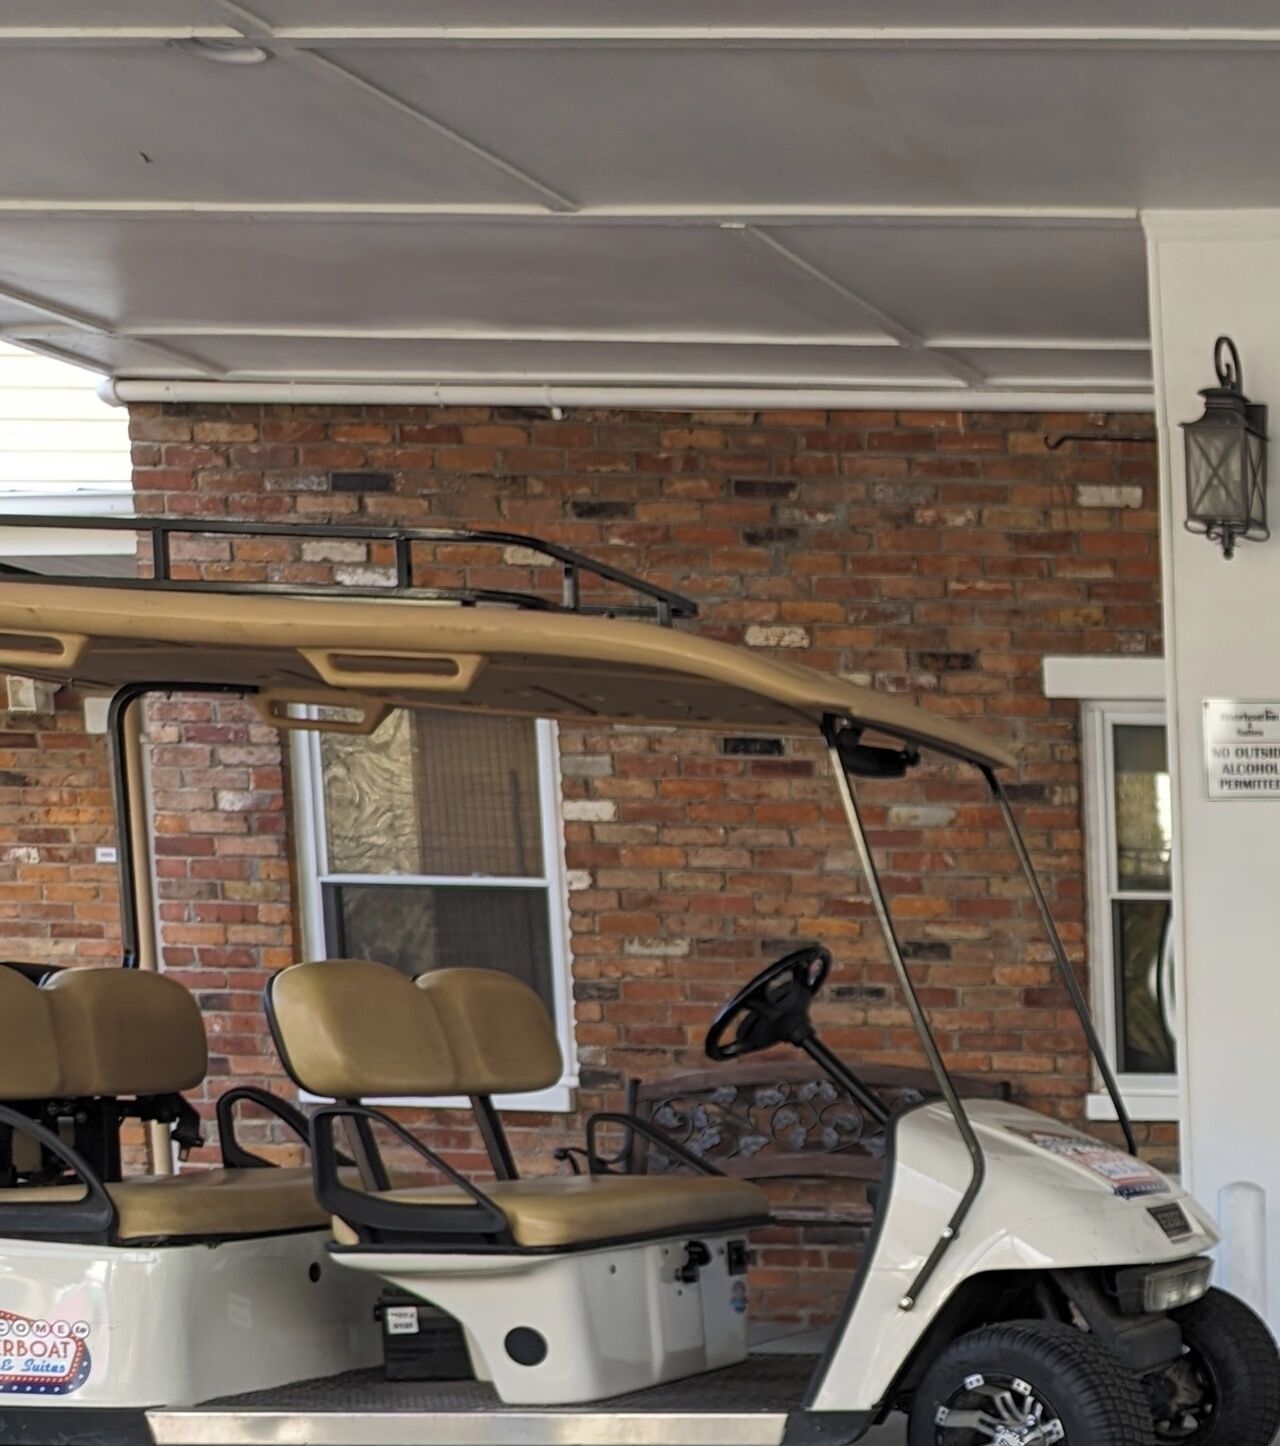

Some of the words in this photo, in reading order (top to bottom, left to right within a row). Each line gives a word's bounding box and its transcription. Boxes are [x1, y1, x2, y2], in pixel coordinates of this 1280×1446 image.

[1212, 747, 1231, 758] NO
[1222, 763, 1280, 775] ALCOHOL
[1, 1359, 15, 1371] &
[21, 1358, 66, 1373] Suites
